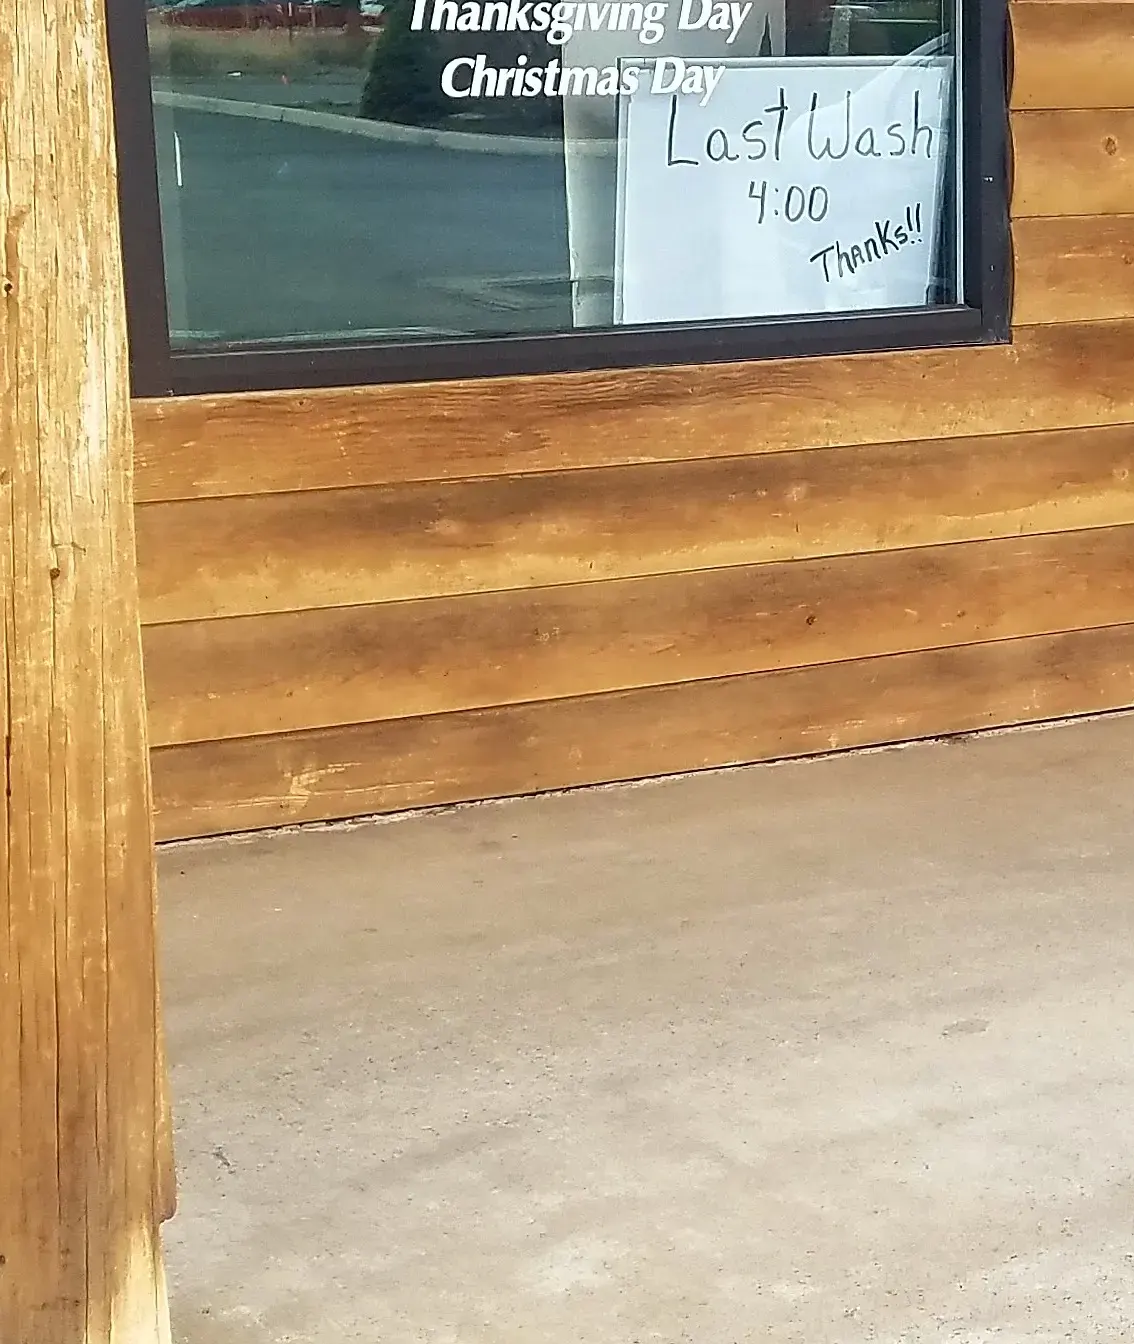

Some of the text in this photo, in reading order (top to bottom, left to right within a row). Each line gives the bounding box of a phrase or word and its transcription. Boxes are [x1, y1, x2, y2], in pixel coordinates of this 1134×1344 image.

[440, 54, 726, 107] Christmas Day
[667, 87, 933, 167] Last Wash
[748, 180, 829, 224] 4:00
